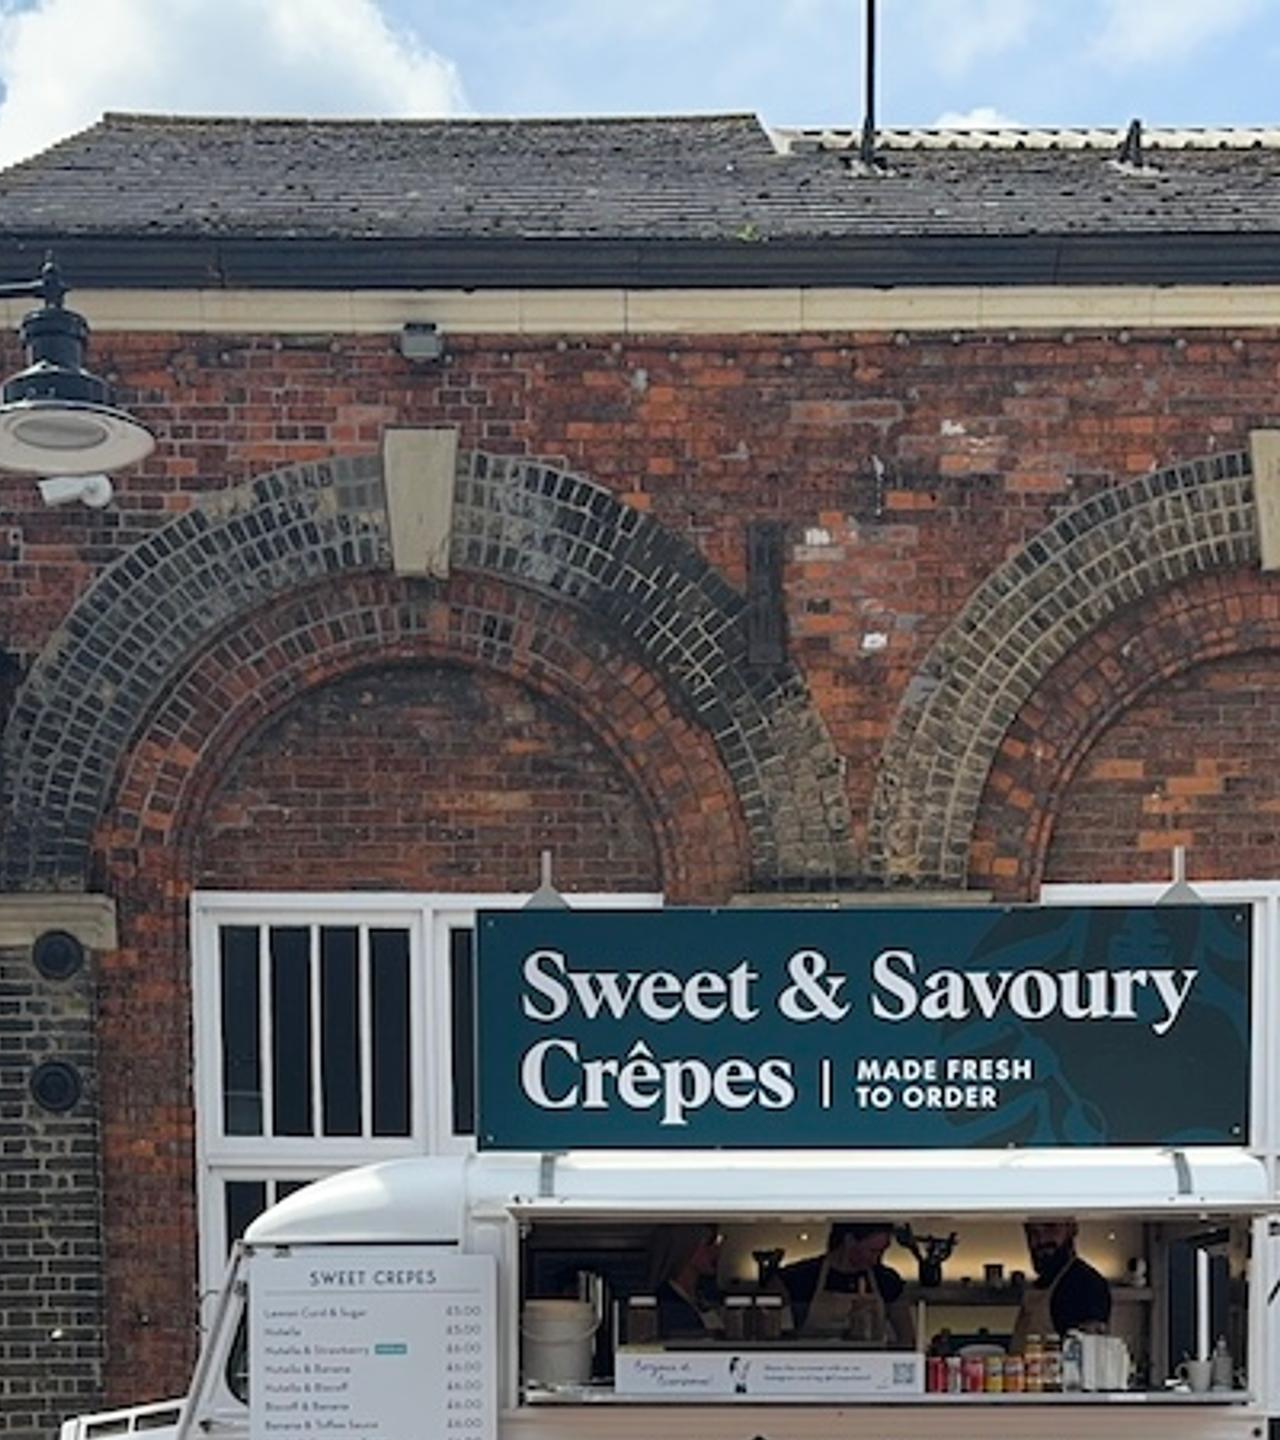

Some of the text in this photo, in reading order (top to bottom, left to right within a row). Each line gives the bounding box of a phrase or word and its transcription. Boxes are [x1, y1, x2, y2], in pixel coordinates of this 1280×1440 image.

[523, 949, 1198, 1033] Sweet & Savoury
[856, 1059, 1033, 1082] MADE FRESH
[522, 1038, 795, 1125] Crêpes
[855, 1086, 998, 1109] TO ORDER
[310, 1269, 366, 1287] SWEET
[263, 1306, 366, 1320] Lemon Curd & Sugar
[265, 1327, 302, 1336] Nutella
[265, 1345, 301, 1355] Nutella
[304, 1345, 311, 1355] &
[314, 1344, 369, 1357] Strawberry
[265, 1363, 351, 1374] Nutella & Banana
[265, 1381, 348, 1392] Nutella & Biscoff
[265, 1401, 350, 1411] Biscoff & Banana
[265, 1419, 379, 1430] Banana & Toffee Sauce
